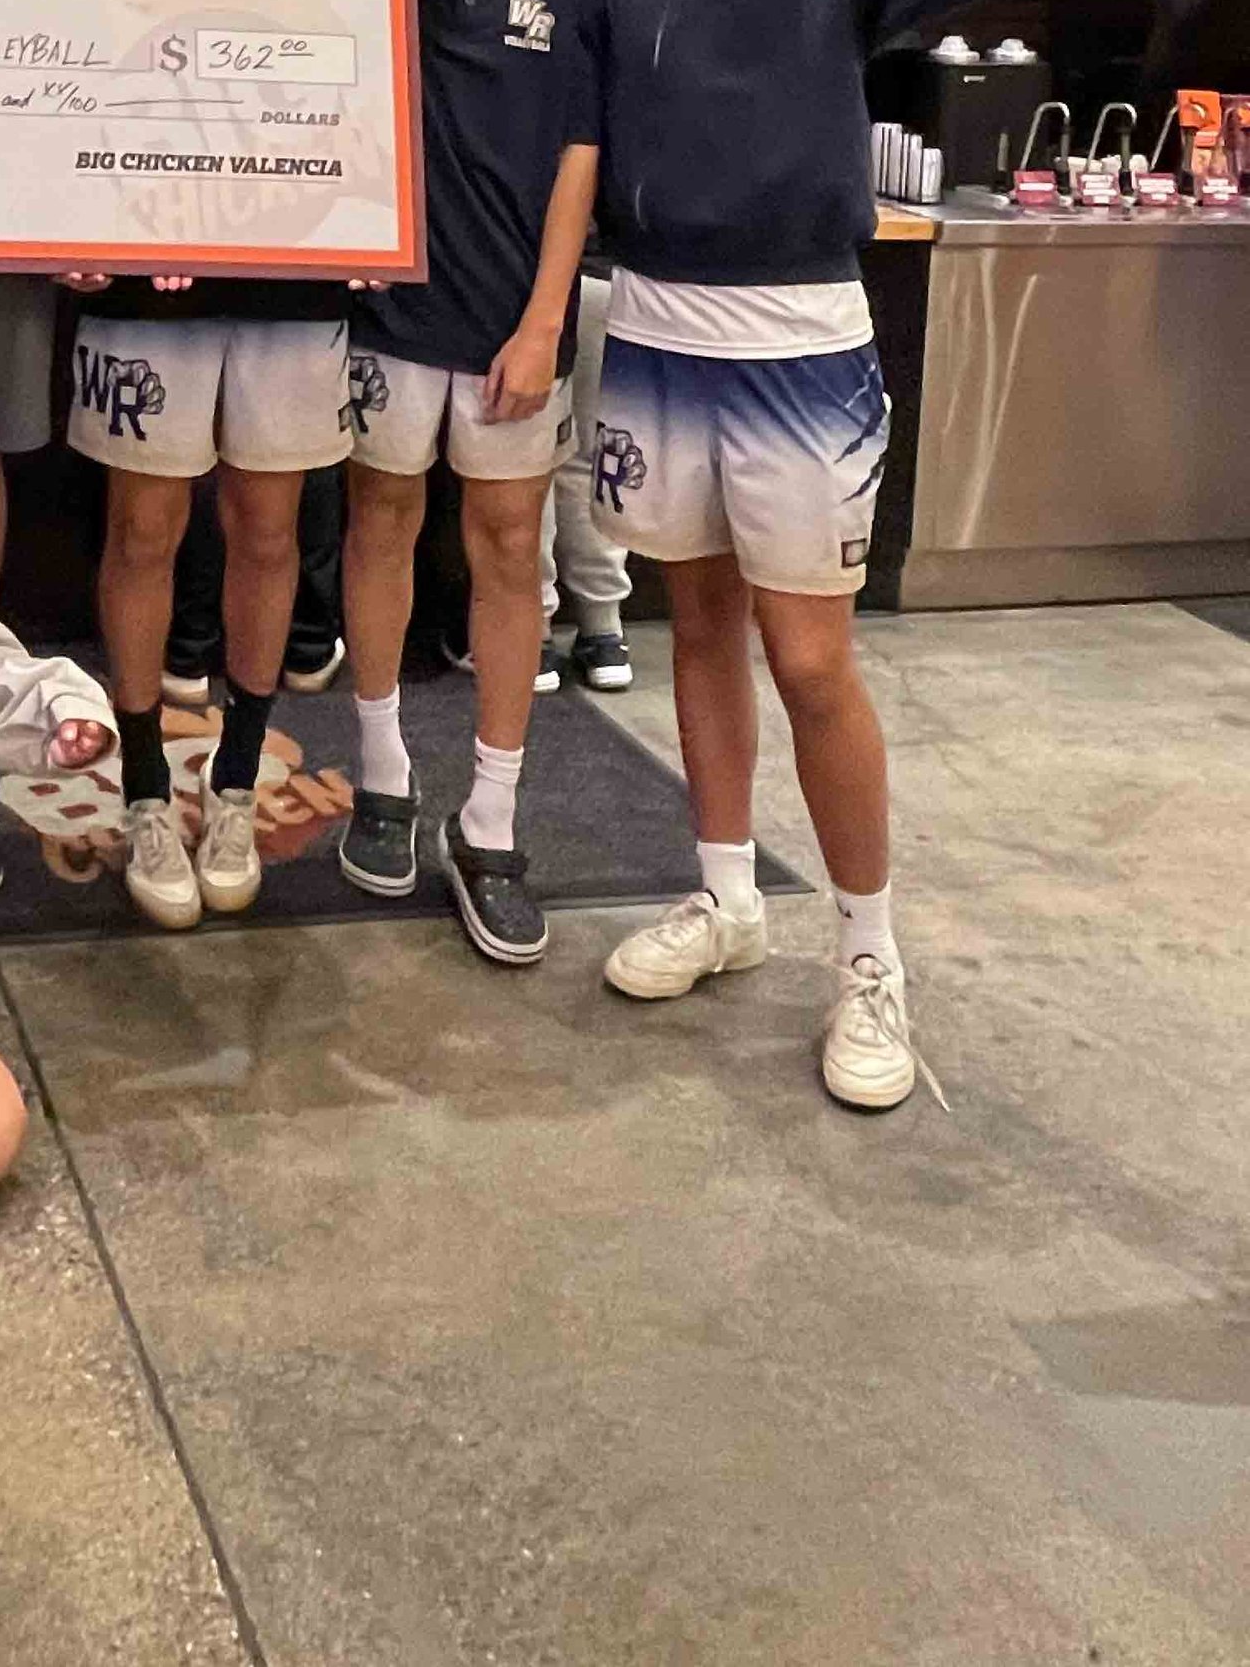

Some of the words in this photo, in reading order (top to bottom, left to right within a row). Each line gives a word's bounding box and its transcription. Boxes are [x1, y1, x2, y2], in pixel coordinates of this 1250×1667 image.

[160, 34, 187, 75] $
[1, 88, 35, 108] and
[260, 111, 339, 127] DOLLARS
[75, 152, 115, 170] BIG
[120, 153, 224, 173] CHICKEN
[230, 156, 342, 177] VALENCIA
